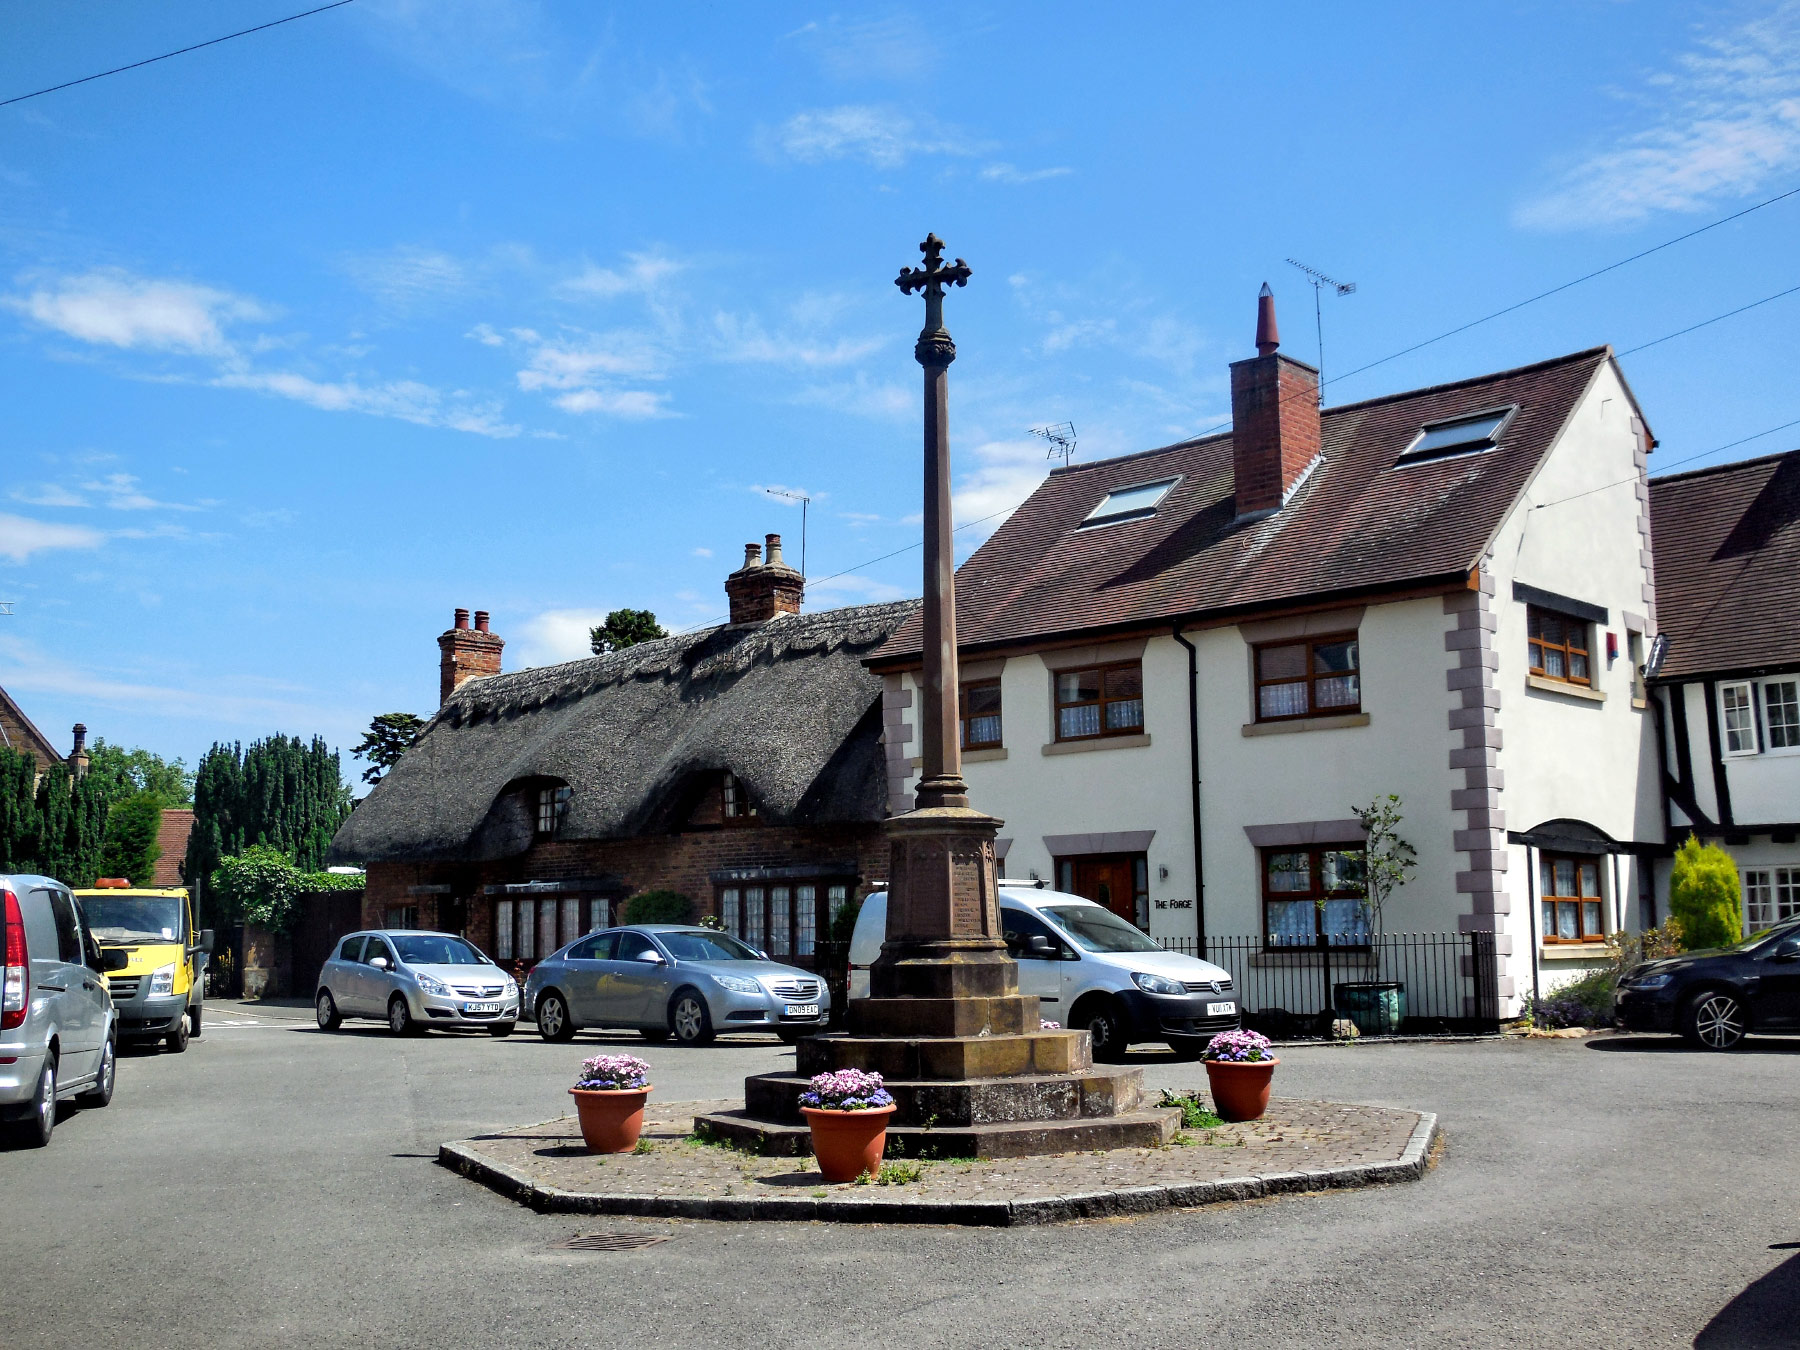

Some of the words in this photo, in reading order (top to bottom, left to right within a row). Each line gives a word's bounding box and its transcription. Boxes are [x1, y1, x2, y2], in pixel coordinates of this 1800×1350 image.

[1154, 899, 1168, 909] THE
[1169, 899, 1193, 909] FORGE
[468, 1003, 485, 1011] KJ57
[486, 1003, 499, 1011] YTD
[788, 1005, 805, 1014] DN09
[806, 1005, 818, 1014] EAC
